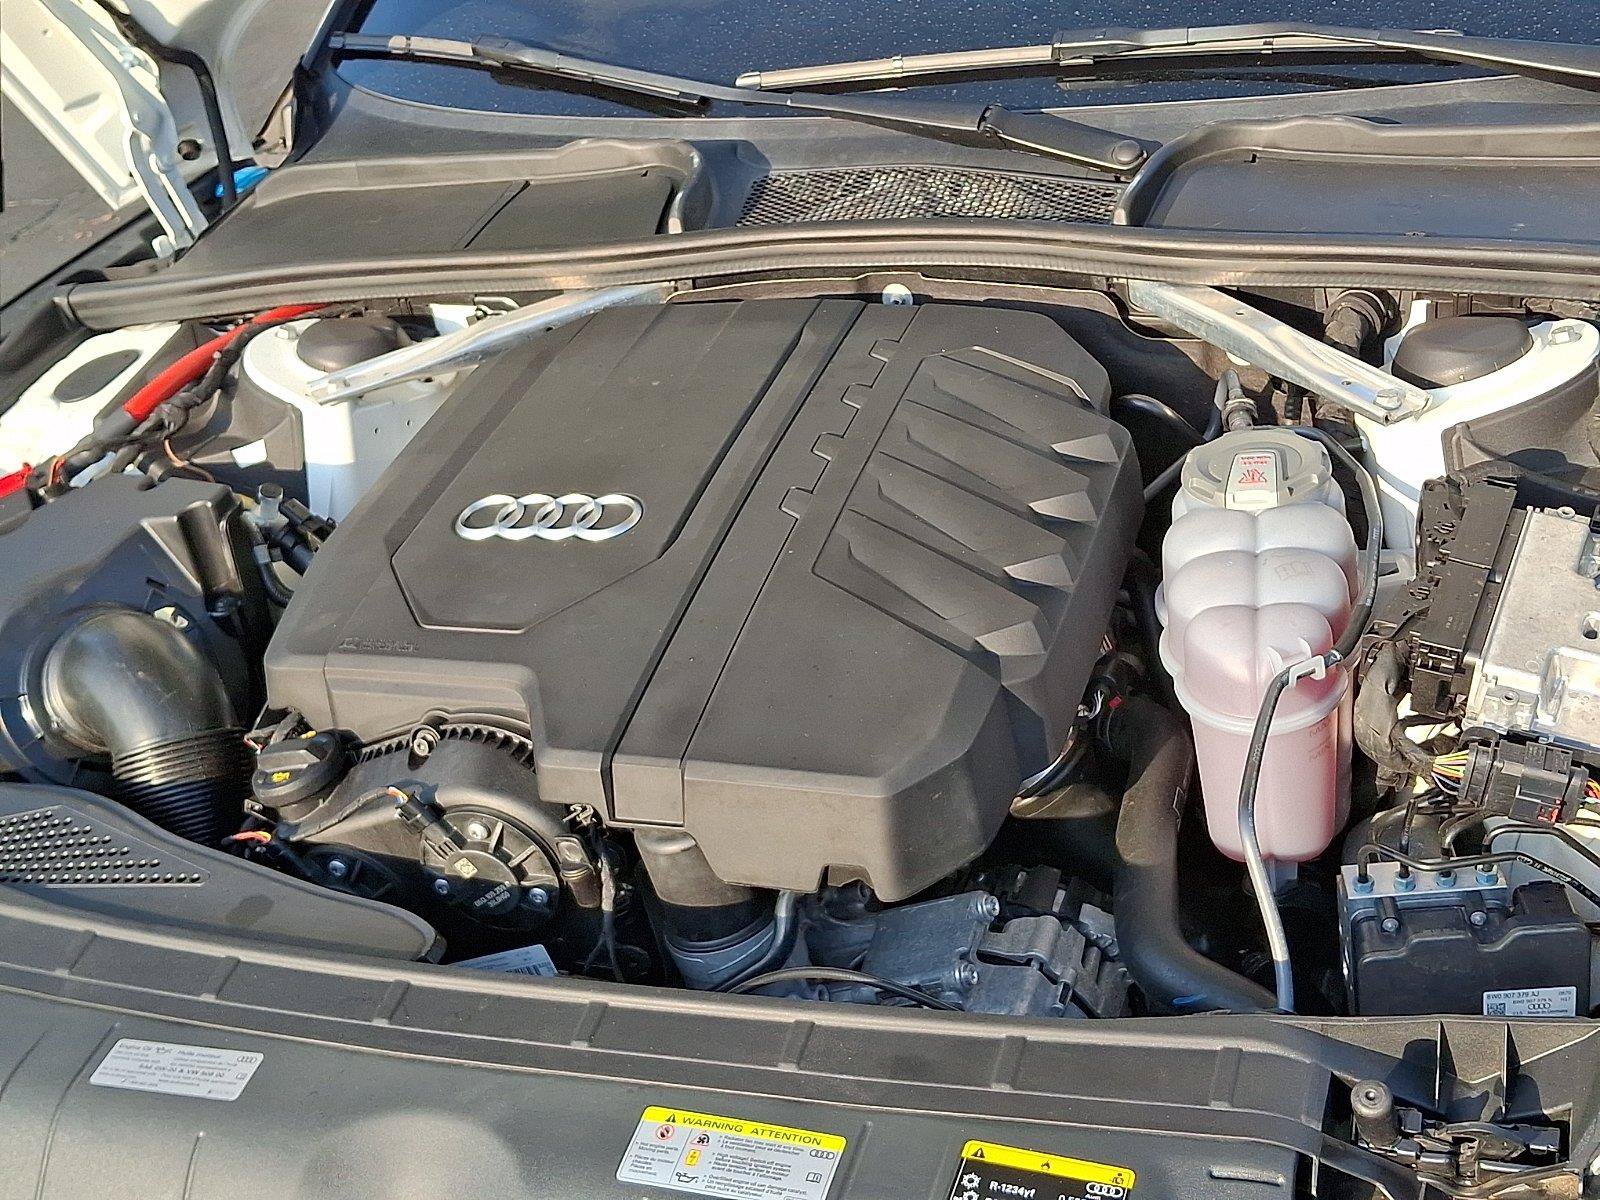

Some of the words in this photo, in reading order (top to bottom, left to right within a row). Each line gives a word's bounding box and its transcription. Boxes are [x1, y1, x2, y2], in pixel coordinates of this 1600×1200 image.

[682, 1116, 744, 1132] WARNING
[751, 1128, 822, 1146] ATTENTION
[988, 1181, 1036, 1199] R-1234yf
